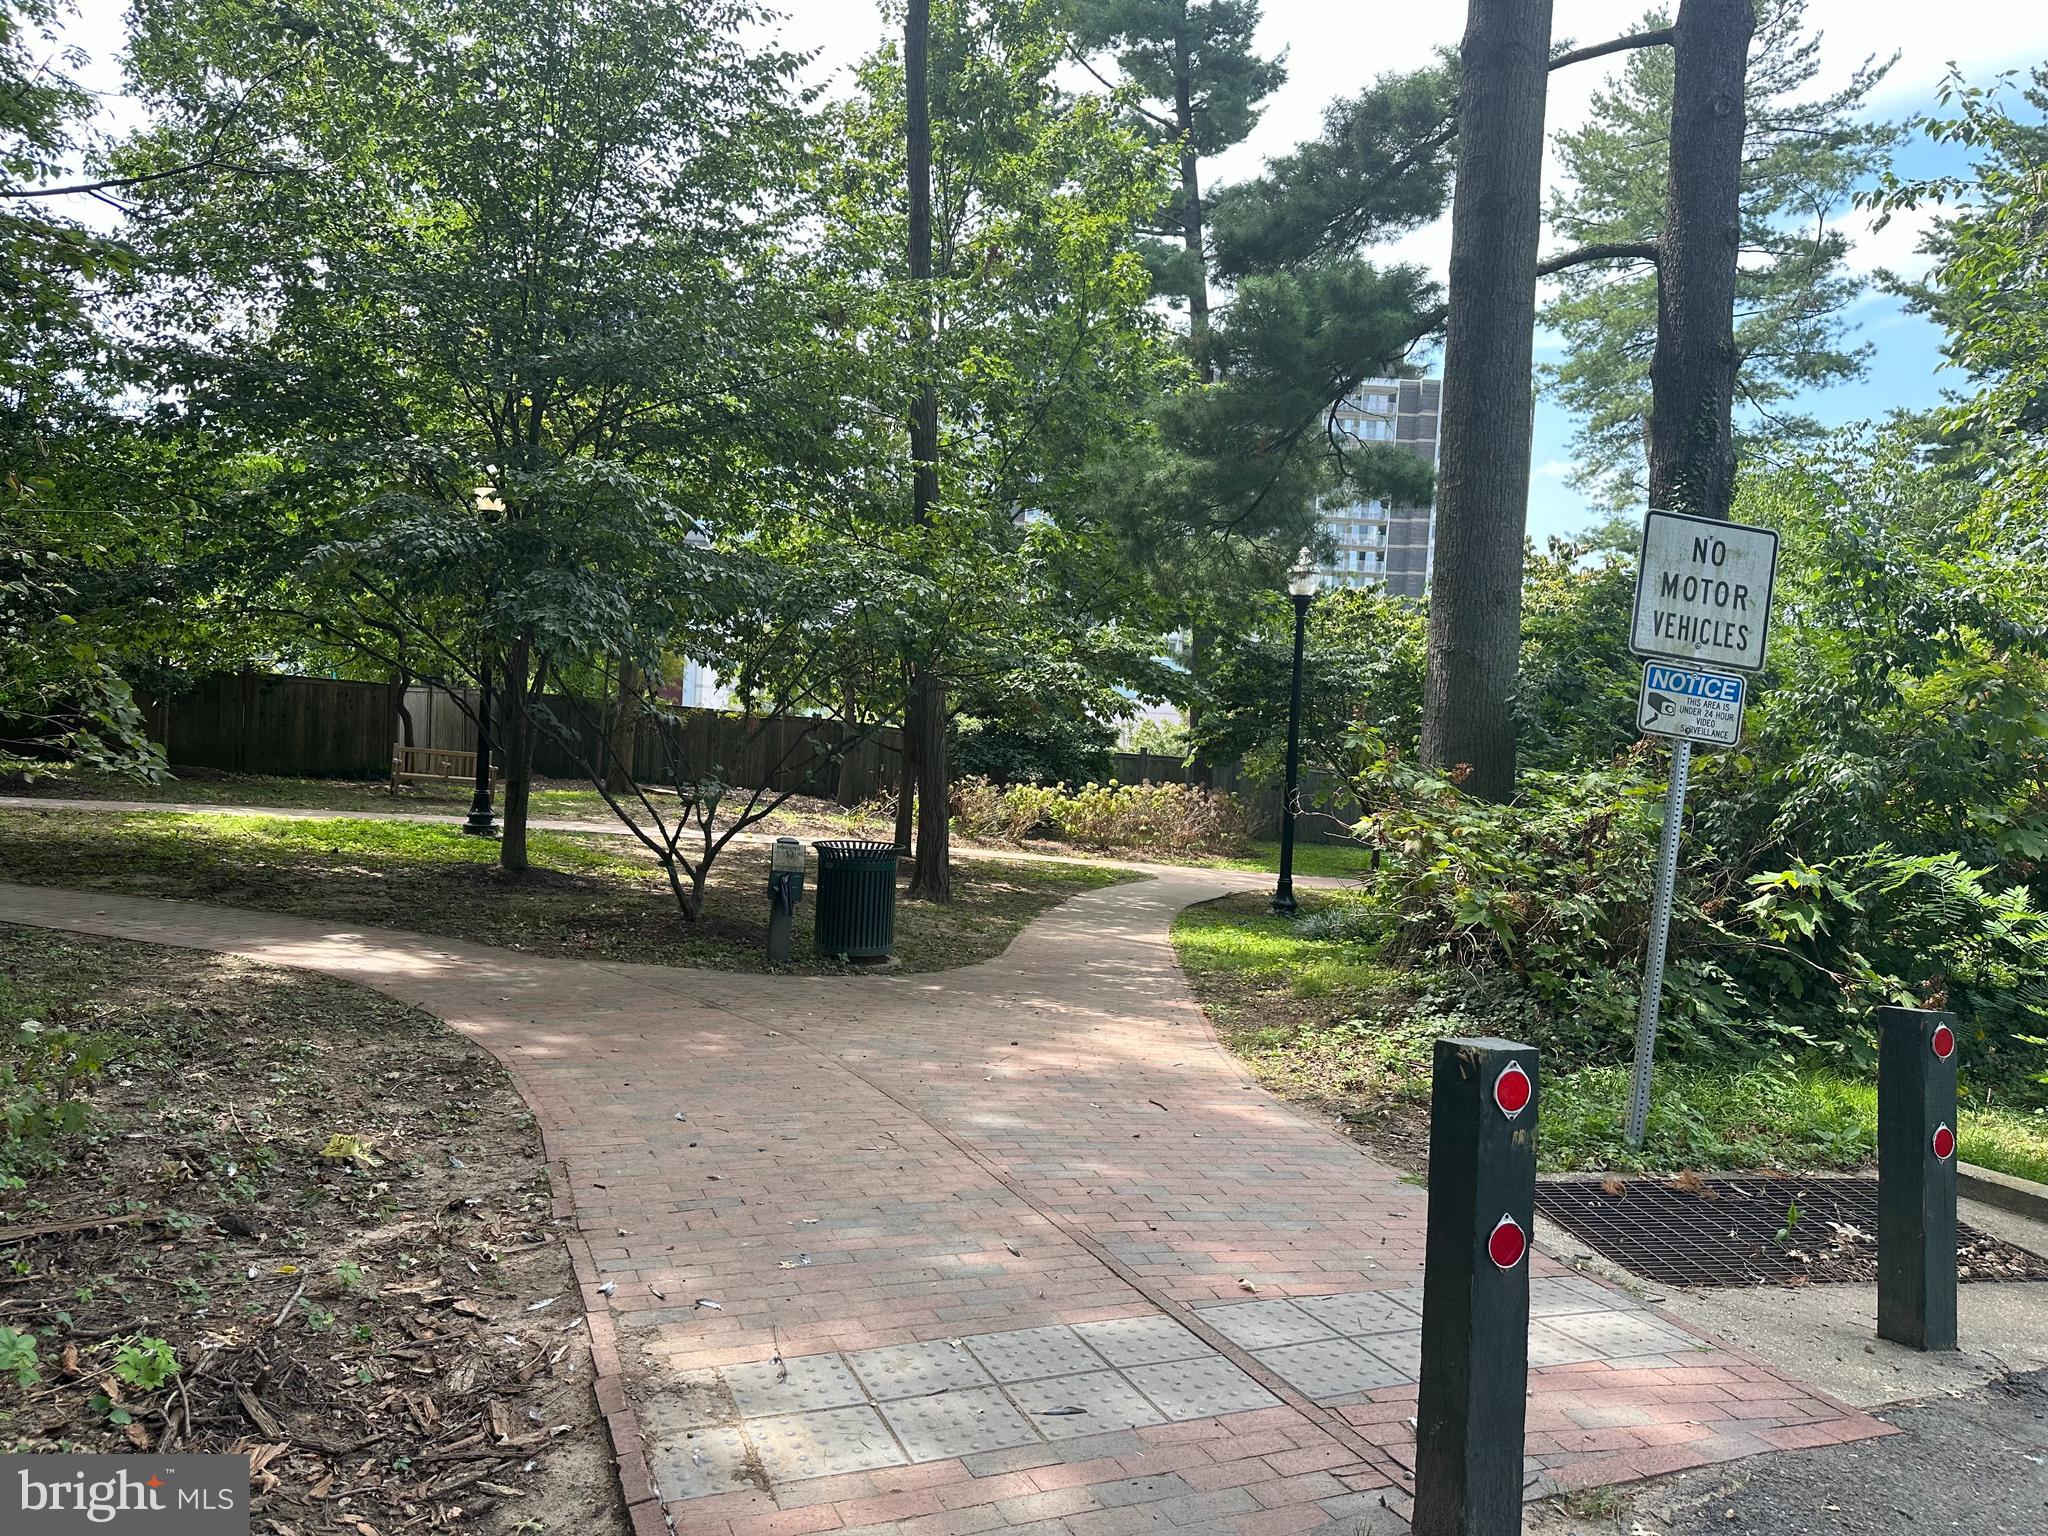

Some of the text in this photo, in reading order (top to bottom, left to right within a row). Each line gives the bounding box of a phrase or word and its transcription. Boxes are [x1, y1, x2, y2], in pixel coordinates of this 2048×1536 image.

[1692, 536, 1726, 566] NO
[1661, 571, 1749, 611] MOTOR
[1654, 610, 1748, 650] VEHICLES
[1652, 670, 1737, 700] NOTICE
[1680, 706, 1702, 716] UNDER
[1716, 712, 1734, 721] HOUR
[1686, 698, 1700, 707] THIS
[1703, 700, 1720, 710] AREA
[1696, 718, 1716, 728] VIDEO
